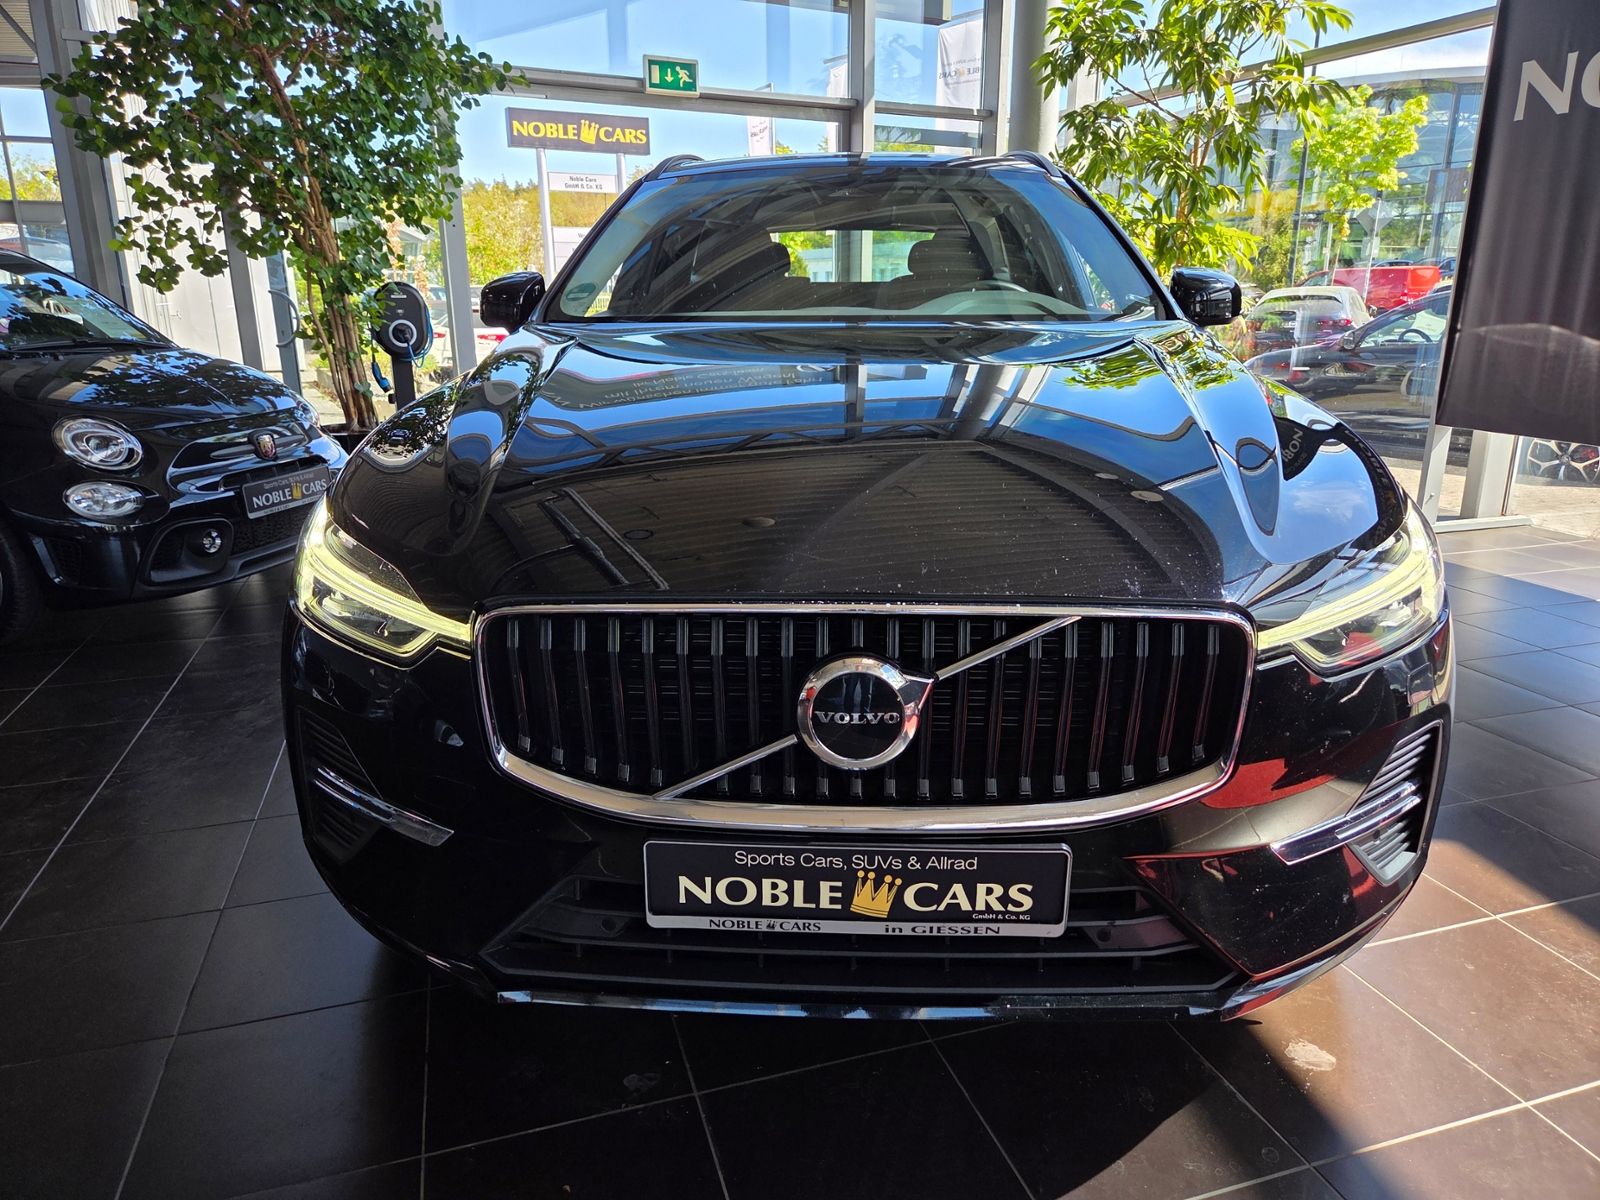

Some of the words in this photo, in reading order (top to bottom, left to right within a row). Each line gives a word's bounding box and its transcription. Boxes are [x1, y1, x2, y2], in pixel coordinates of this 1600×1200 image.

[512, 120, 578, 140] NOBLE
[599, 127, 647, 144] CARS
[252, 488, 292, 508] NOBLE
[302, 478, 327, 494] CARS
[814, 711, 900, 725] VOLVO
[735, 850, 795, 868] Sports
[800, 852, 848, 870] Cars,
[852, 854, 902, 870] SUVs
[908, 856, 921, 869] &
[925, 855, 978, 870] Allrad
[678, 875, 843, 909] NOBLE
[903, 882, 1034, 913] CARS
[709, 919, 763, 930] NOBLE
[779, 921, 822, 932] CARS
[884, 923, 903, 934] in
[911, 924, 1001, 935] GIESSEN
